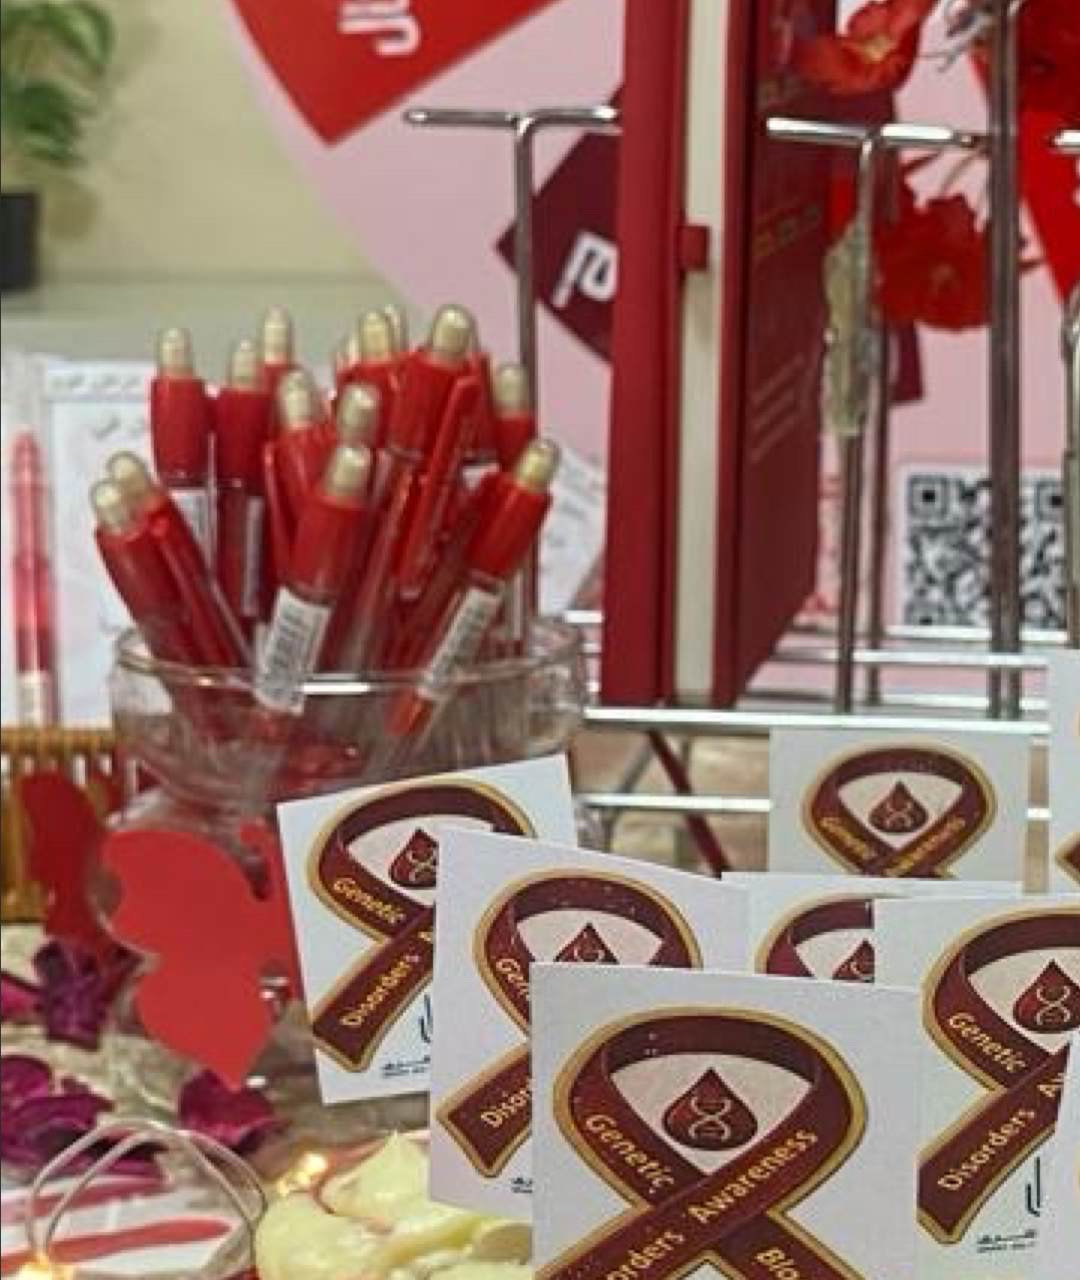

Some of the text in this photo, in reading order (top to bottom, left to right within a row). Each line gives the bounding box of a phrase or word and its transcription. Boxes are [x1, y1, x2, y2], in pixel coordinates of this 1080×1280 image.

[333, 876, 406, 924] Genetic
[340, 951, 420, 1027] Disorders
[949, 1012, 1028, 1074] Genetic
[585, 1114, 676, 1190] Genetic
[684, 1129, 820, 1224] Awareness
[938, 1107, 1037, 1193] Disorders
